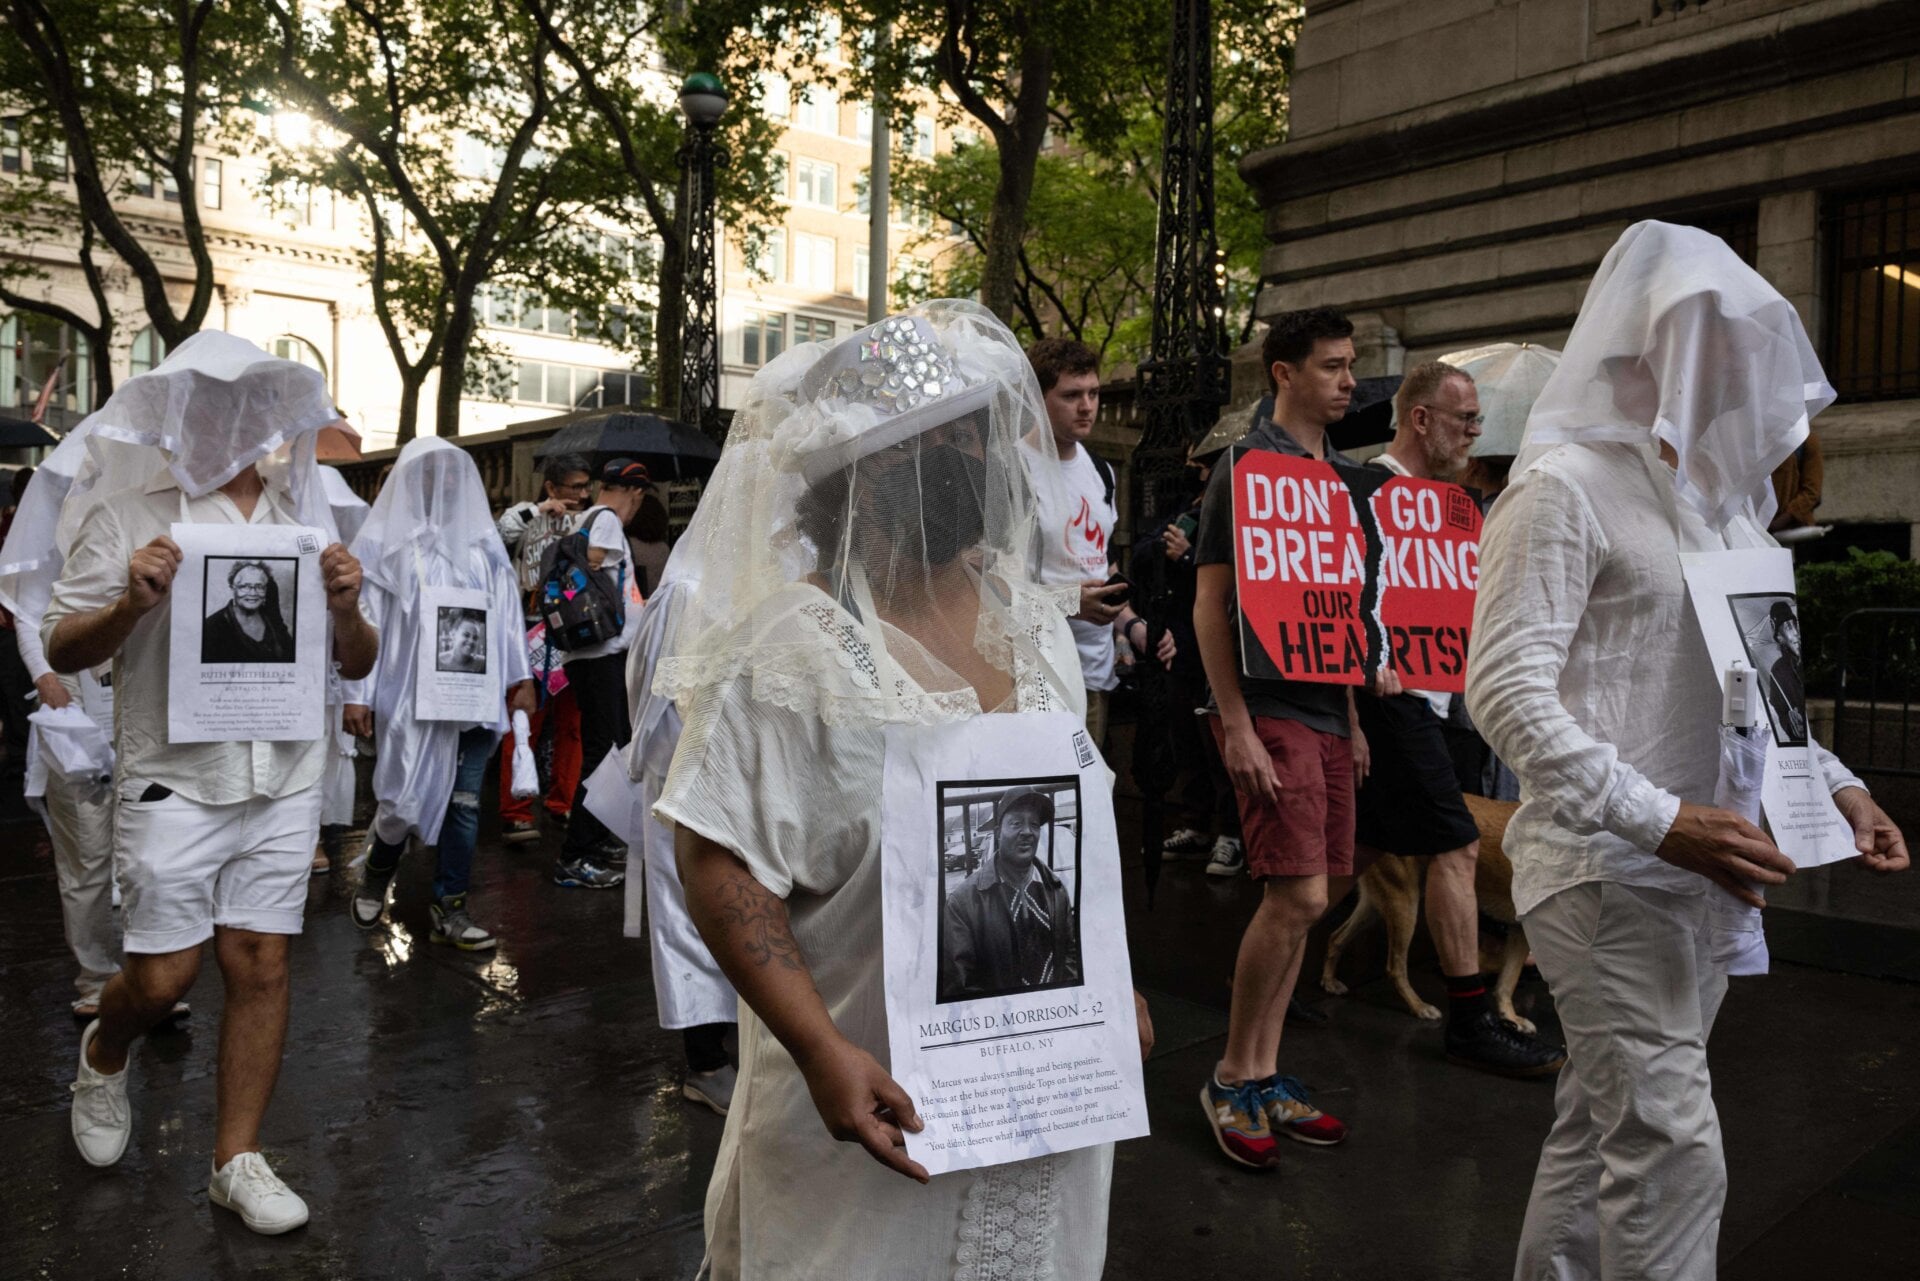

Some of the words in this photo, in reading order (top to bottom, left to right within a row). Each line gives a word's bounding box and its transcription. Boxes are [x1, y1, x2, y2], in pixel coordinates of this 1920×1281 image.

[1246, 473, 1382, 528] DON'T
[1390, 486, 1442, 533] GO
[1242, 526, 1481, 591] BREAKING
[1303, 590, 1354, 620] OUR
[920, 1016, 981, 1038] MARGUS
[984, 1015, 999, 1029] D.
[1002, 1003, 1079, 1027] MORRISON
[1092, 1001, 1103, 1017] 52
[980, 1040, 1035, 1057] BUFFALO,
[1038, 1038, 1054, 1049] NY
[920, 1096, 934, 1106] He
[950, 1094, 957, 1102] at
[959, 1091, 972, 1101] the
[974, 1089, 988, 1098] bus
[989, 1087, 1006, 1097] stop
[1008, 1079, 1036, 1092] outside
[1036, 1078, 1056, 1089] Tops
[1057, 1076, 1067, 1084] on
[1068, 1074, 1079, 1083] his
[1080, 1072, 1095, 1082] way
[1095, 1069, 1118, 1079] home.
[931, 1078, 961, 1090] Marcus
[963, 1076, 978, 1084] was
[979, 1072, 1005, 1082] always
[1006, 1066, 1034, 1078] smiling
[1036, 1064, 1050, 1073] and
[1052, 1060, 1073, 1071] being
[1074, 1057, 1103, 1070] positive.
[952, 1122, 965, 1133] His
[965, 1116, 994, 1130] brother
[996, 1113, 1018, 1126] asked
[1020, 1109, 1048, 1121] another
[1049, 1105, 1074, 1117] cousin
[1075, 1103, 1083, 1112] to
[1084, 1101, 1099, 1113] post
[961, 1105, 977, 1116] said
[978, 1103, 988, 1113] he
[989, 1102, 1004, 1111] was
[1036, 1094, 1051, 1106] guy
[1052, 1090, 1069, 1100] who
[1069, 1087, 1083, 1098] will
[1084, 1085, 1094, 1095] be
[967, 1135, 993, 1147] deserve
[994, 1130, 1014, 1141] what
[1015, 1123, 1052, 1139] happened
[1053, 1119, 1080, 1131] because
[1081, 1116, 1089, 1126] of
[1090, 1113, 1104, 1124] that
